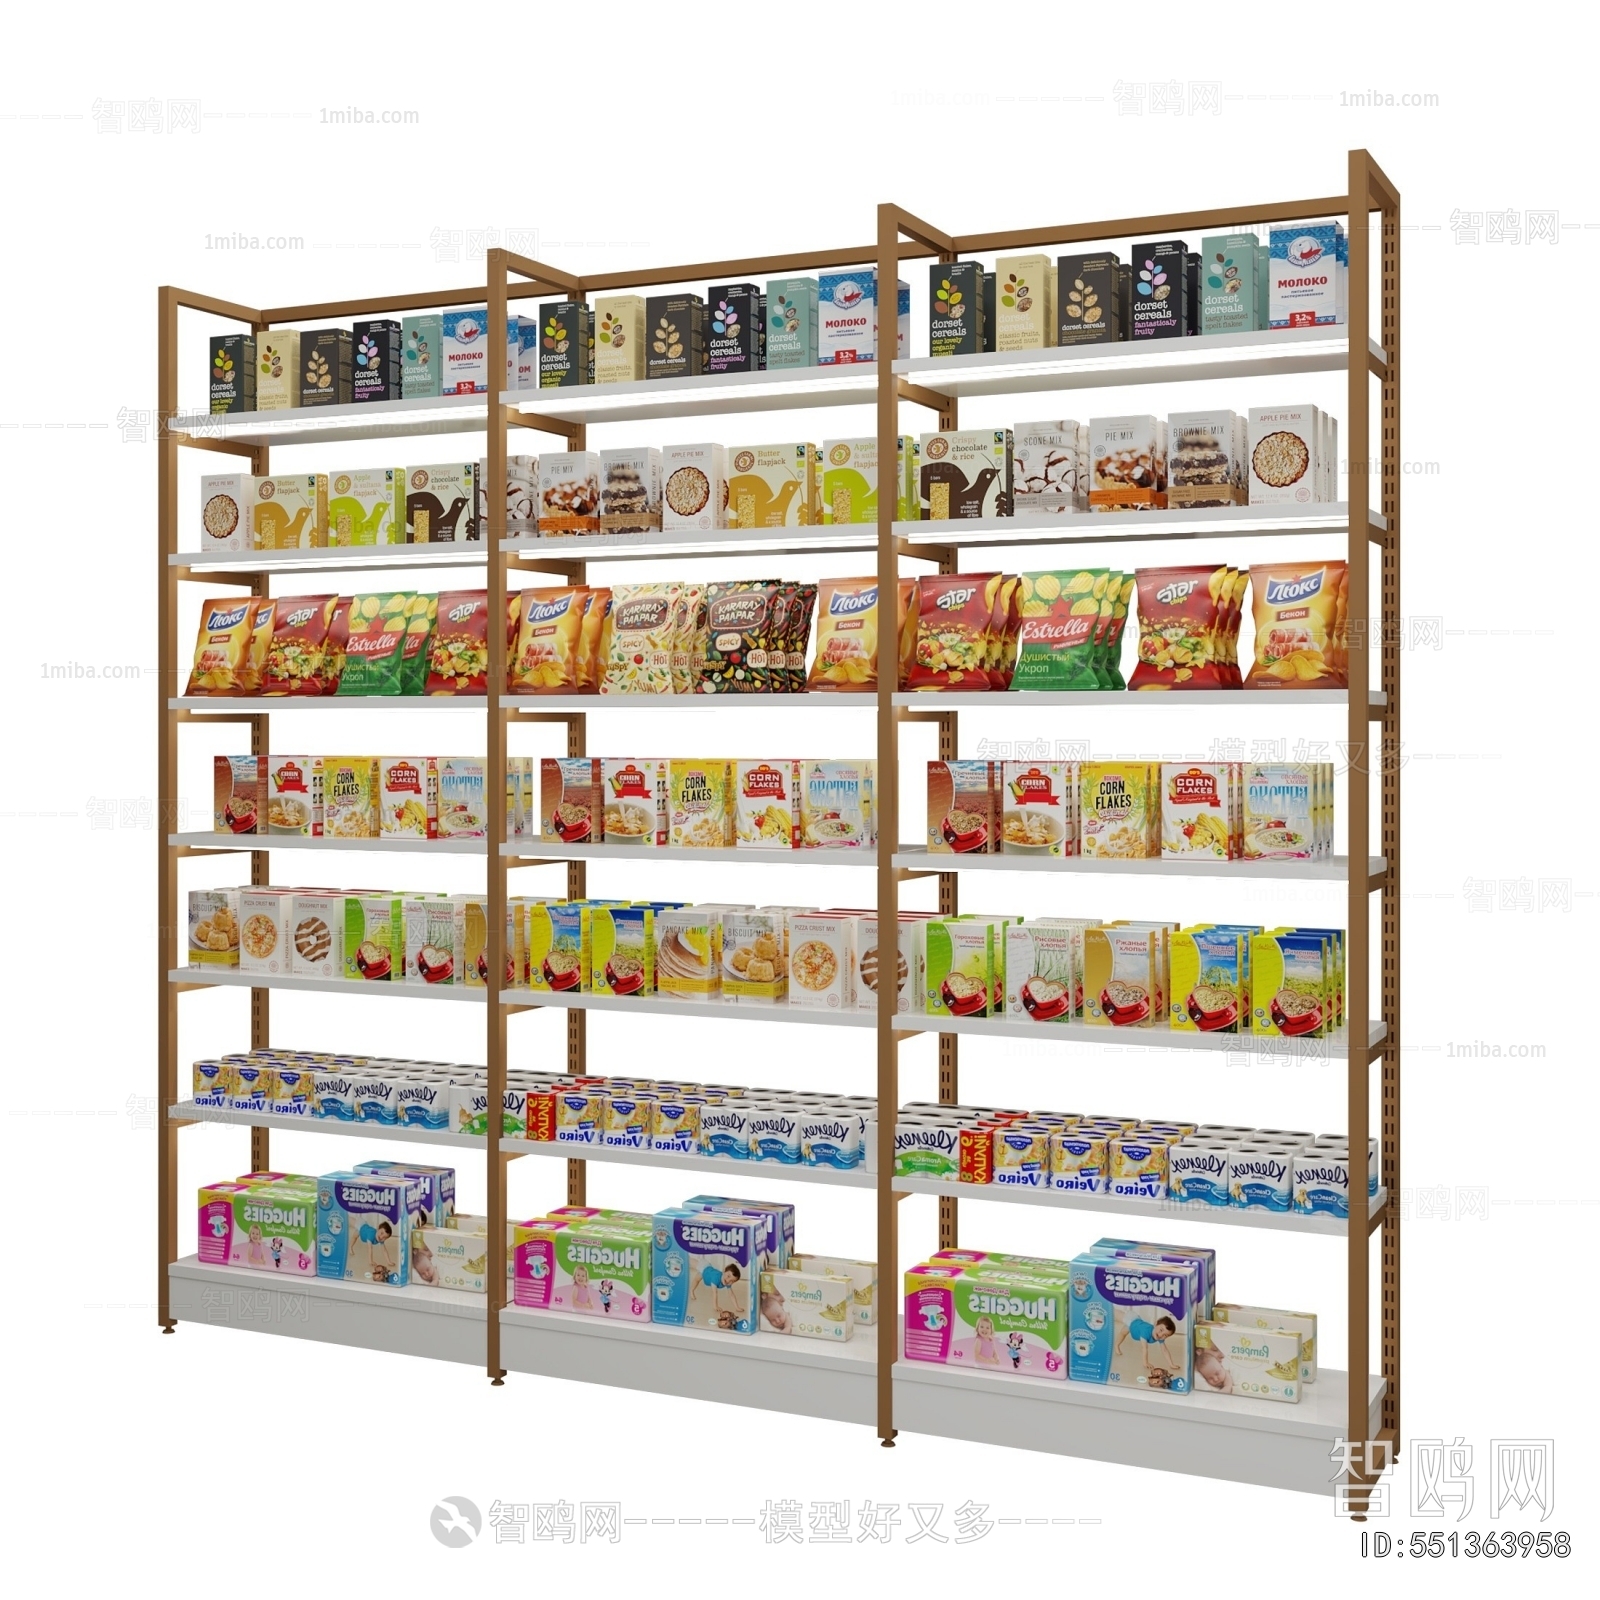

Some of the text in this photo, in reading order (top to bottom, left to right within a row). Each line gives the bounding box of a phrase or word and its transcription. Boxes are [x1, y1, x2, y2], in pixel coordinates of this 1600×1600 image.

[1277, 276, 1328, 289] МОЛОКО
[1134, 299, 1168, 311] dorset
[1204, 294, 1240, 305] dorset
[1204, 303, 1243, 315] cereals
[1134, 309, 1172, 321] cereals
[825, 317, 867, 329] МОЛОКО
[932, 319, 963, 329] dorset
[1062, 321, 1106, 331] dorset cereals
[932, 328, 967, 339] cereals
[1134, 327, 1156, 337] fruity
[711, 338, 740, 348] dorset
[769, 333, 798, 343] dorset
[944, 336, 963, 346] lovely
[711, 345, 741, 357] cereals
[769, 341, 801, 352] cereals
[448, 351, 484, 363] МОЛОКО
[541, 353, 567, 362] dorset
[404, 365, 428, 375] dorset
[541, 361, 571, 371] cereals
[354, 370, 380, 379] dorset
[404, 373, 432, 384] cereals
[354, 377, 382, 388] cereals
[1259, 414, 1278, 422] APPLE
[1279, 413, 1289, 421] PIE
[1105, 431, 1134, 442] PIE MIX
[1173, 426, 1225, 438] BROWNIE MIX
[1024, 434, 1063, 446] SCONE MIX
[952, 443, 988, 453] chocolate
[757, 450, 781, 458] Butter
[960, 453, 975, 461] rice
[604, 461, 645, 472] BROWNIE MIX
[757, 457, 787, 467] flapjack
[551, 464, 573, 475] PIE MIX
[431, 475, 460, 485] chocolate
[622, 603, 663, 616] KARARAY
[717, 600, 761, 613] KARARAY
[622, 611, 659, 624] PAAPAR
[718, 608, 755, 622] PAAPAR
[1279, 609, 1307, 620] Бекон
[837, 620, 861, 629] Бекон
[1023, 618, 1090, 639] Estrella
[535, 626, 555, 636] Бекон
[346, 633, 398, 652] Estrella
[652, 653, 668, 665] HOT
[673, 654, 688, 666] HOT
[750, 652, 766, 664] HOT
[769, 652, 785, 664] HOT
[787, 653, 803, 667] HOT
[1020, 652, 1070, 664] Душистый
[1018, 663, 1049, 675] Укроп
[335, 772, 355, 785] CORN
[390, 769, 417, 777] CORN
[619, 774, 640, 782] CORN
[749, 773, 780, 782] CORN
[390, 776, 417, 784] FLAKES
[685, 777, 706, 789] CORN
[749, 781, 780, 789] FLAKES
[1020, 779, 1046, 787] CORN
[1176, 778, 1213, 787] CORN
[333, 783, 360, 797] FLAKES
[1099, 780, 1125, 795] CORN
[1176, 787, 1213, 795] FLAKES
[681, 787, 712, 803] FLAKES
[1095, 794, 1132, 810] FLAKES
[661, 926, 703, 935] PANCAKE MIX
[727, 928, 753, 937] BISCUIT
[794, 924, 826, 932] PIZZA CRUST
[1034, 935, 1067, 945] Рисовые
[1040, 941, 1067, 950] хлопья
[1115, 938, 1148, 949] Ржаные
[1119, 945, 1148, 954] хлопья
